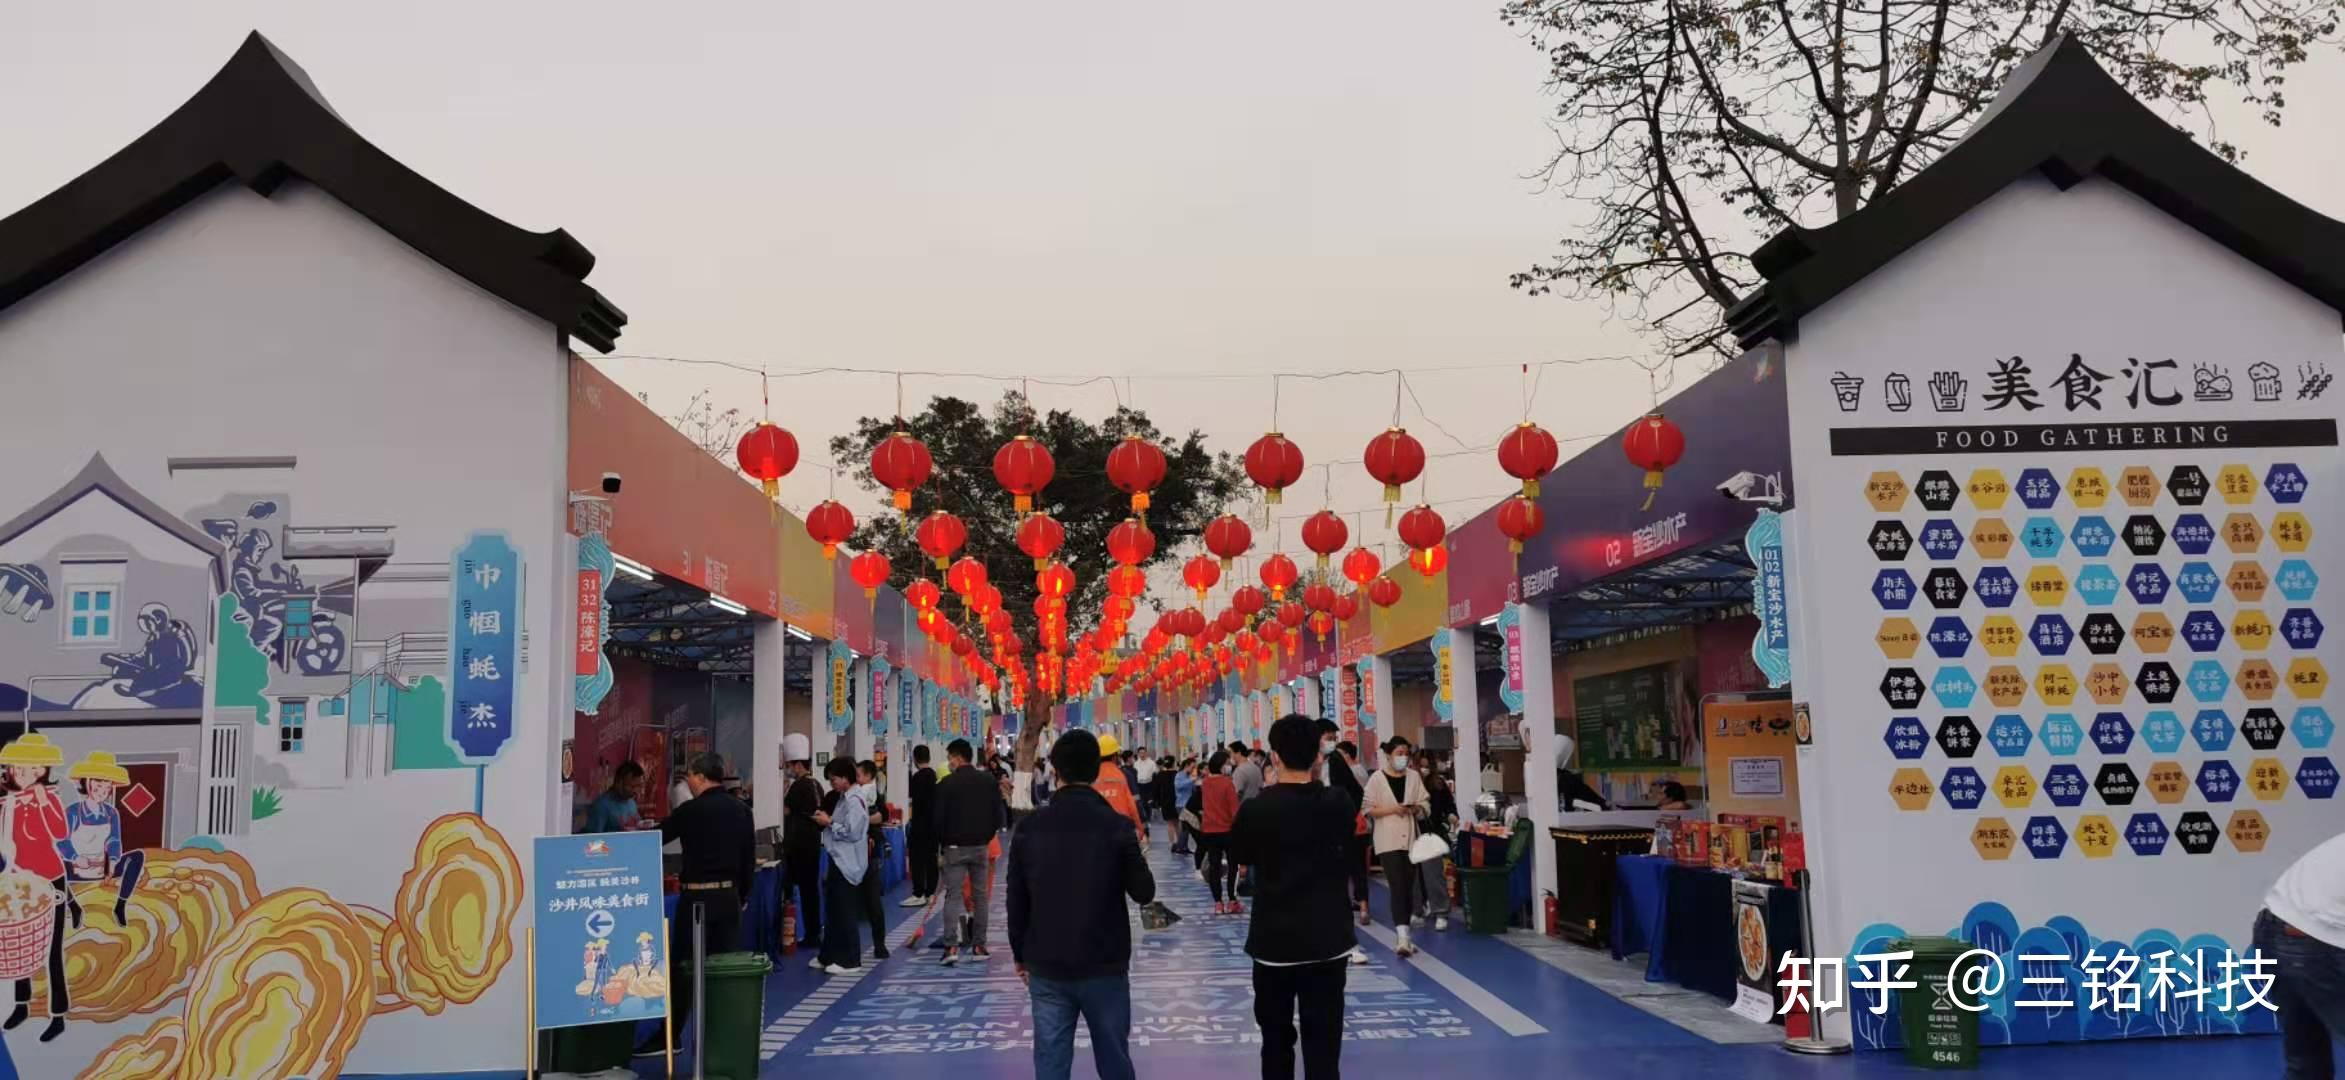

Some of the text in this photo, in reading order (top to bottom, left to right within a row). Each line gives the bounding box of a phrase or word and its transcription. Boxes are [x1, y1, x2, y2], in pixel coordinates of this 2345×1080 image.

[1981, 353, 2184, 412] 美食汇
[1935, 425, 2231, 449] FOOD GATHERING
[2274, 472, 2297, 483] 沙井
[1605, 540, 1622, 568] 02
[1765, 549, 1779, 560] 01
[683, 549, 692, 577] 31
[1765, 562, 1780, 573] 02
[583, 578, 597, 591] 31
[1883, 577, 1906, 588] 功夫
[2137, 584, 2161, 594] 食品
[1507, 582, 1519, 602] 03
[581, 593, 597, 606] 32
[1766, 574, 1785, 645] 新宝沙水产
[2091, 624, 2114, 633] 沙井
[467, 563, 501, 730] 巾帼蚝杰
[2039, 635, 2064, 645] 酒店
[1891, 691, 1917, 700] 拉面
[549, 892, 650, 914] 沙井风味美食街
[820, 1029, 1009, 1043] OYSTER
[1932, 1050, 1961, 1063] 4546
